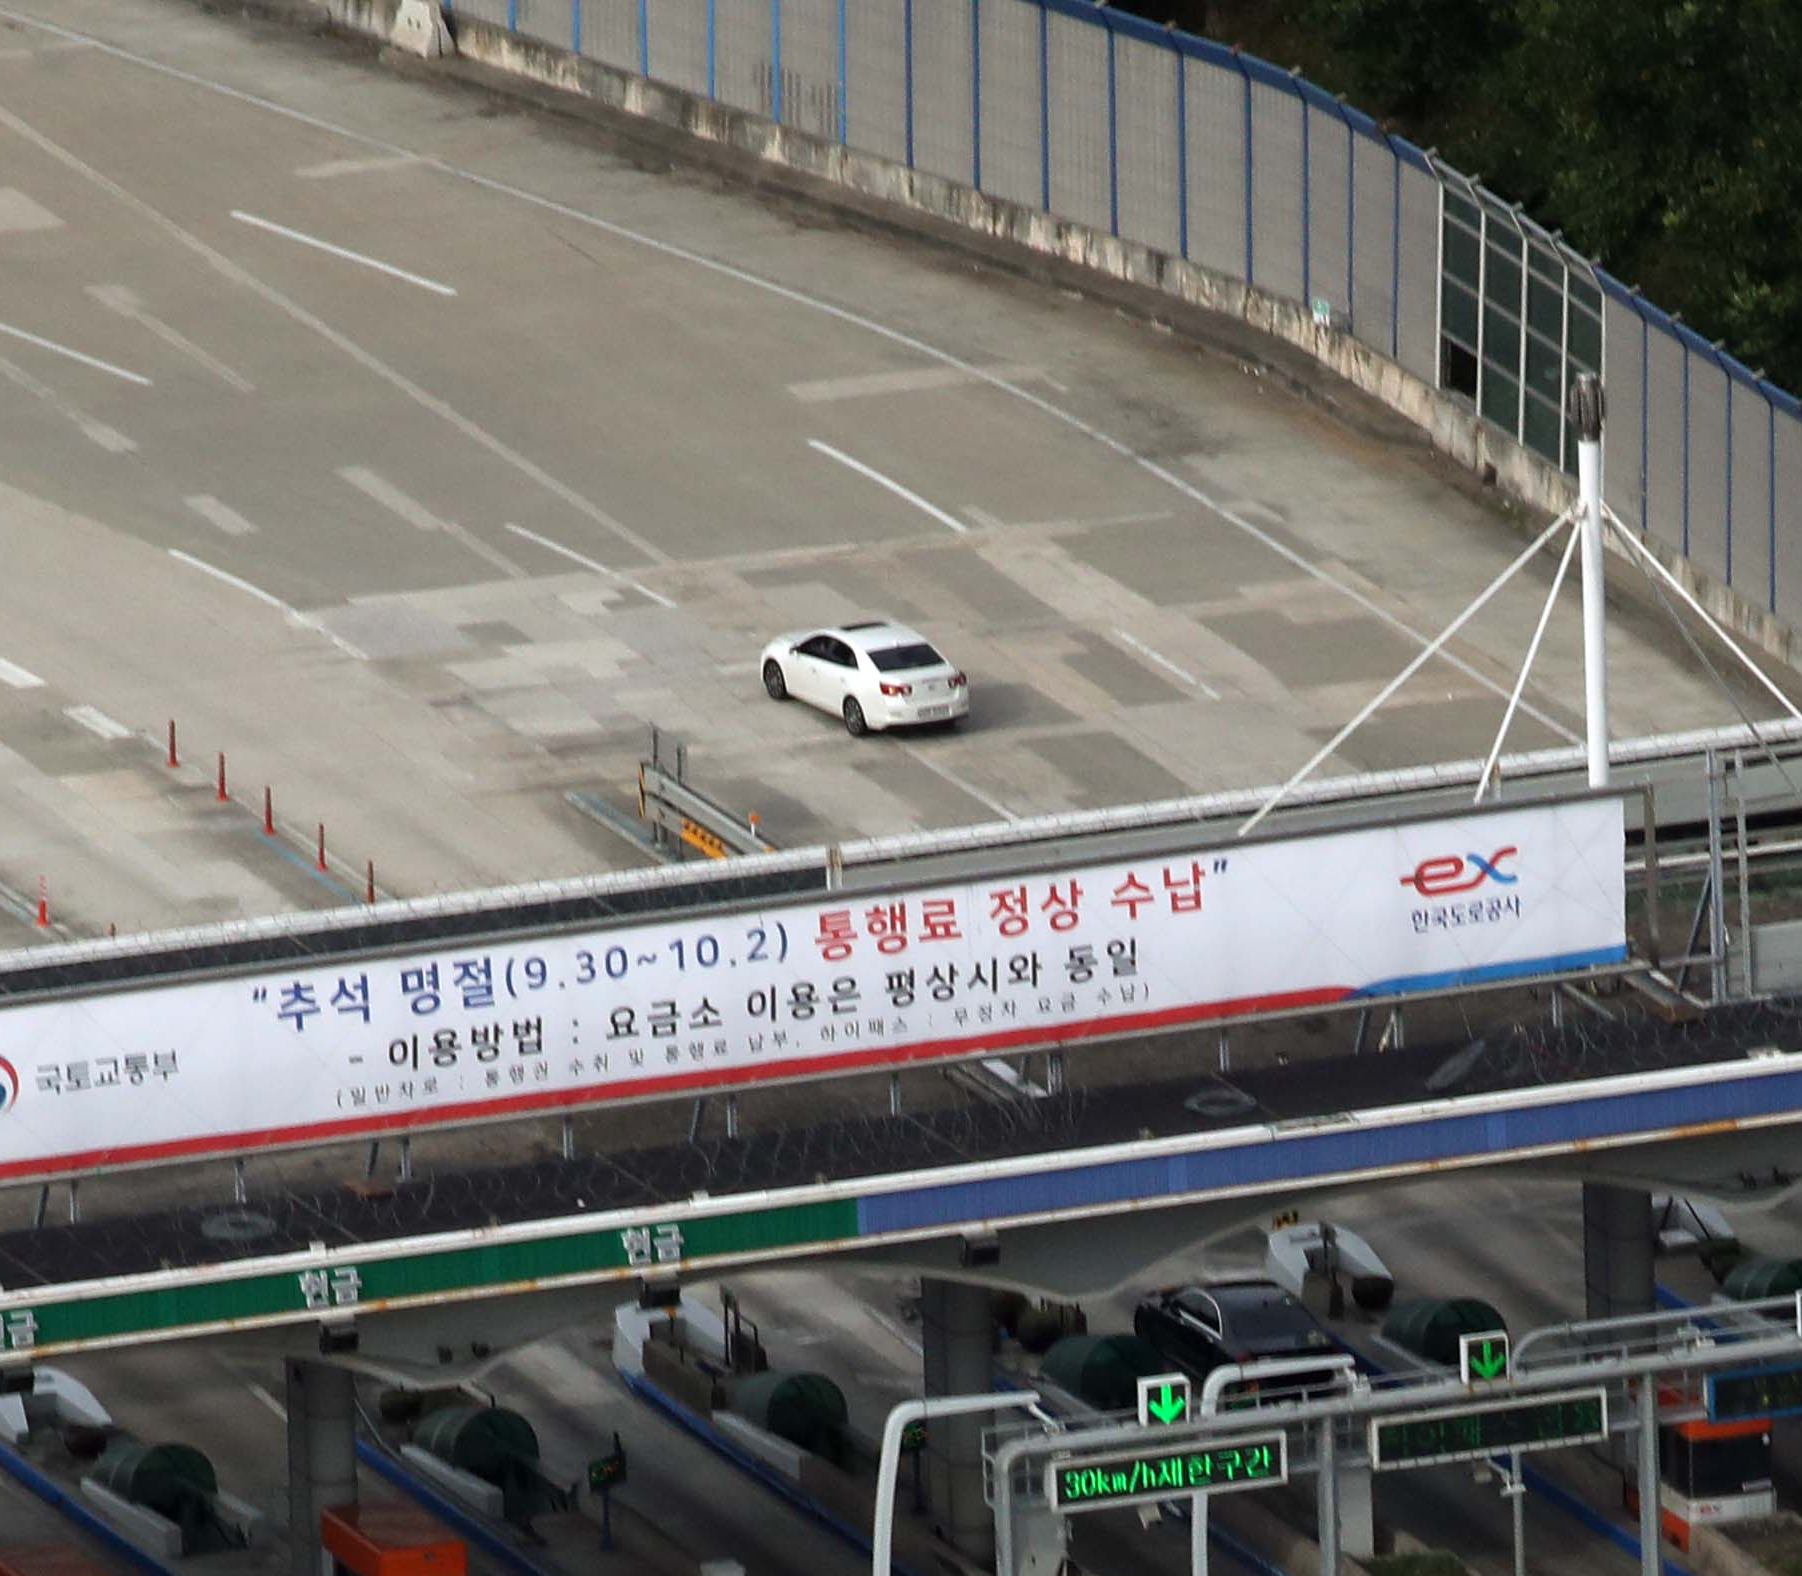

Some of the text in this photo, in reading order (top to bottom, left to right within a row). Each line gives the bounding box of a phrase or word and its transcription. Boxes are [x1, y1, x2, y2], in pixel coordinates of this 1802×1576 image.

[814, 899, 963, 961] 통행료
[989, 879, 1085, 939] 정상
[1411, 894, 1520, 933] 한국도로공사
[388, 1016, 543, 1072] 이용방법
[605, 997, 724, 1041] 요금소
[746, 976, 862, 1025] 이용은
[884, 950, 1043, 1009] 평상시와
[1064, 937, 1139, 986] 동일
[35, 1048, 180, 1096] 국토교통부
